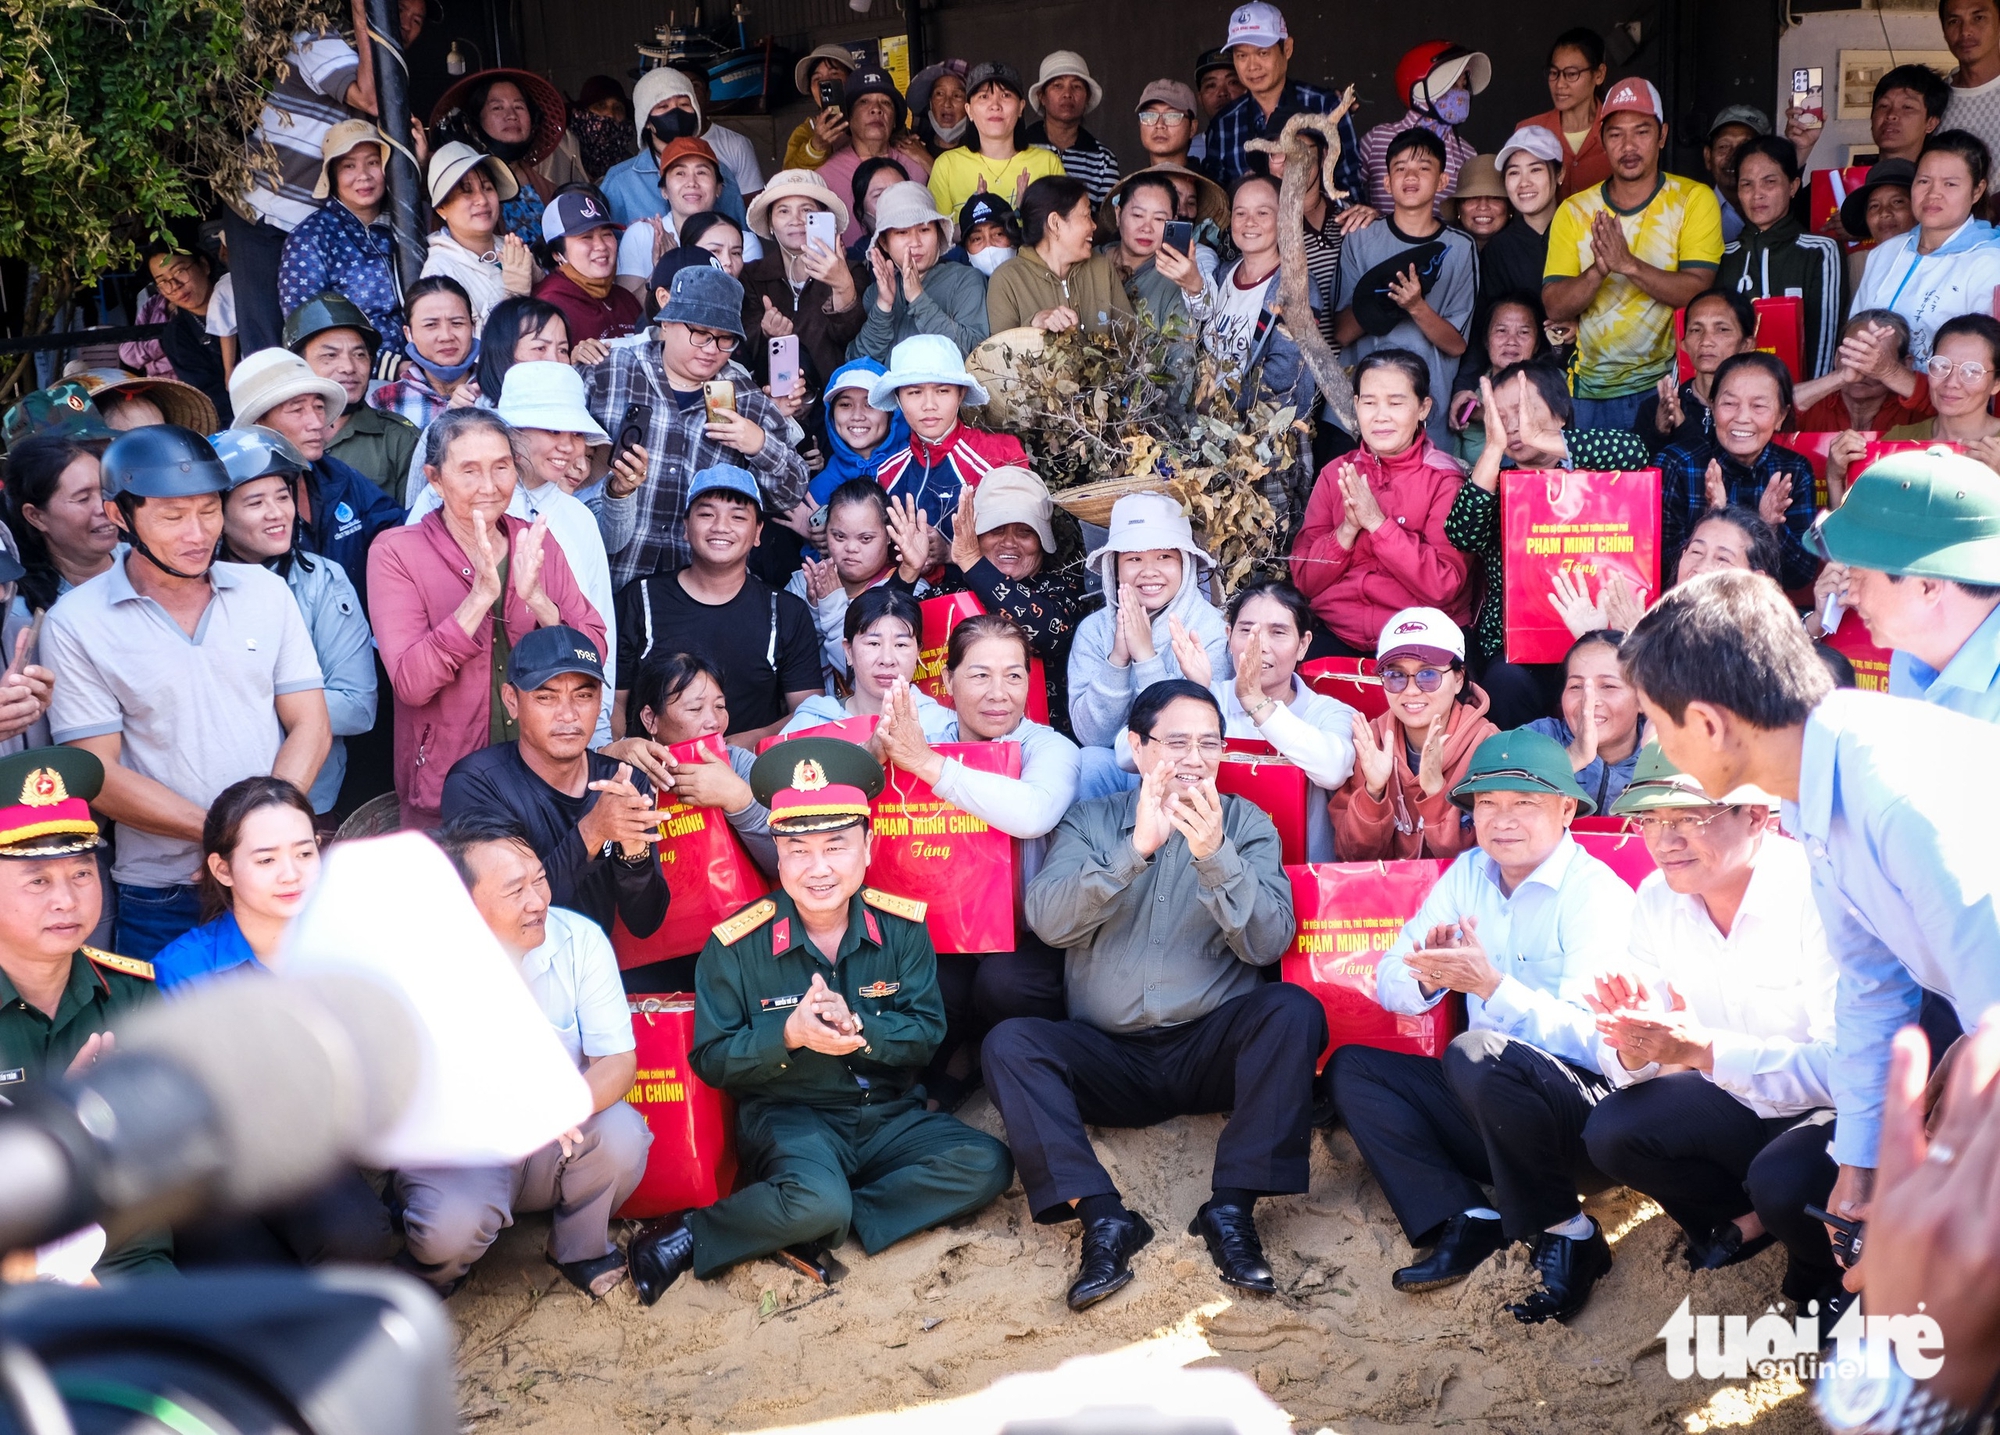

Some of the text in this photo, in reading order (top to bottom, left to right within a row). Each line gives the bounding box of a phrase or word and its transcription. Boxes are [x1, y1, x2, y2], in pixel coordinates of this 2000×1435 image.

[1526, 532, 1634, 558] PHẠM MINH CHÍNH
[574, 649, 597, 663] 1985
[667, 812, 706, 838] CHÍNH
[873, 811, 988, 839] PHẠM MINH CHÍNH
[911, 841, 951, 860] Tặng
[1353, 917, 1363, 929] THỦ
[1379, 917, 1394, 928] CHÍNH
[1298, 935, 1334, 957] PHẠM
[1336, 933, 1370, 953] MINH
[1335, 962, 1375, 979] Tặng
[645, 1080, 685, 1103] CHÍNH
